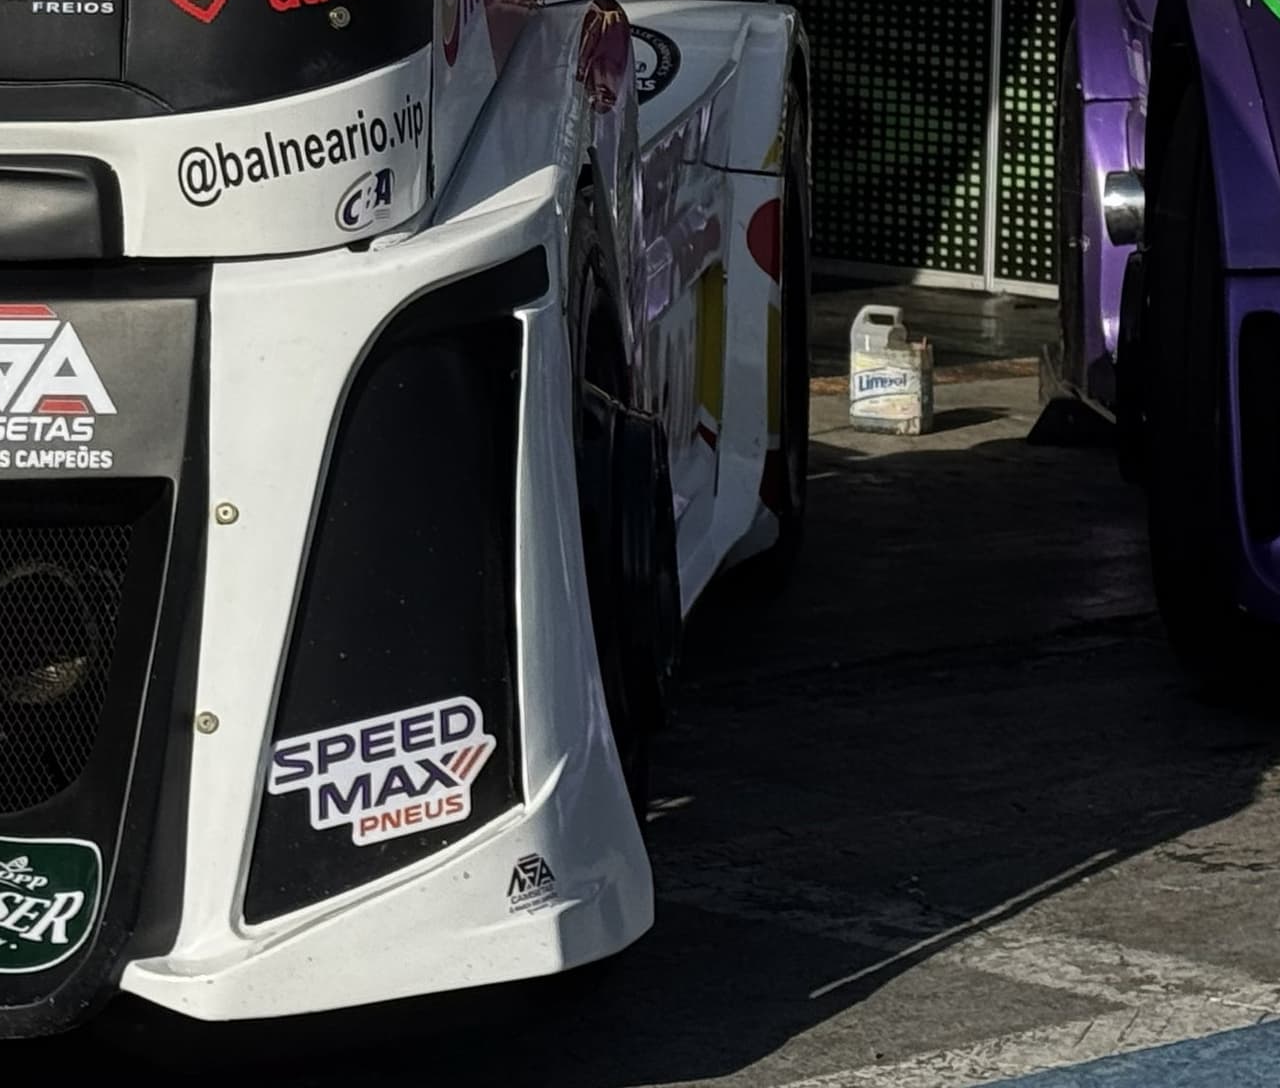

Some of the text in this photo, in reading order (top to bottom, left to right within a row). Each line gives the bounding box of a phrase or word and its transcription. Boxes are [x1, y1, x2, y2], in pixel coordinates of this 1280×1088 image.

[32, 1, 115, 14] FREIOS
[177, 93, 425, 208] @balneario.vip
[858, 373, 908, 392] Limpol
[15, 445, 114, 469] CAMPEÕES
[273, 703, 477, 787] SPEED
[317, 749, 465, 821] MAX
[359, 792, 466, 839] PNEUS
